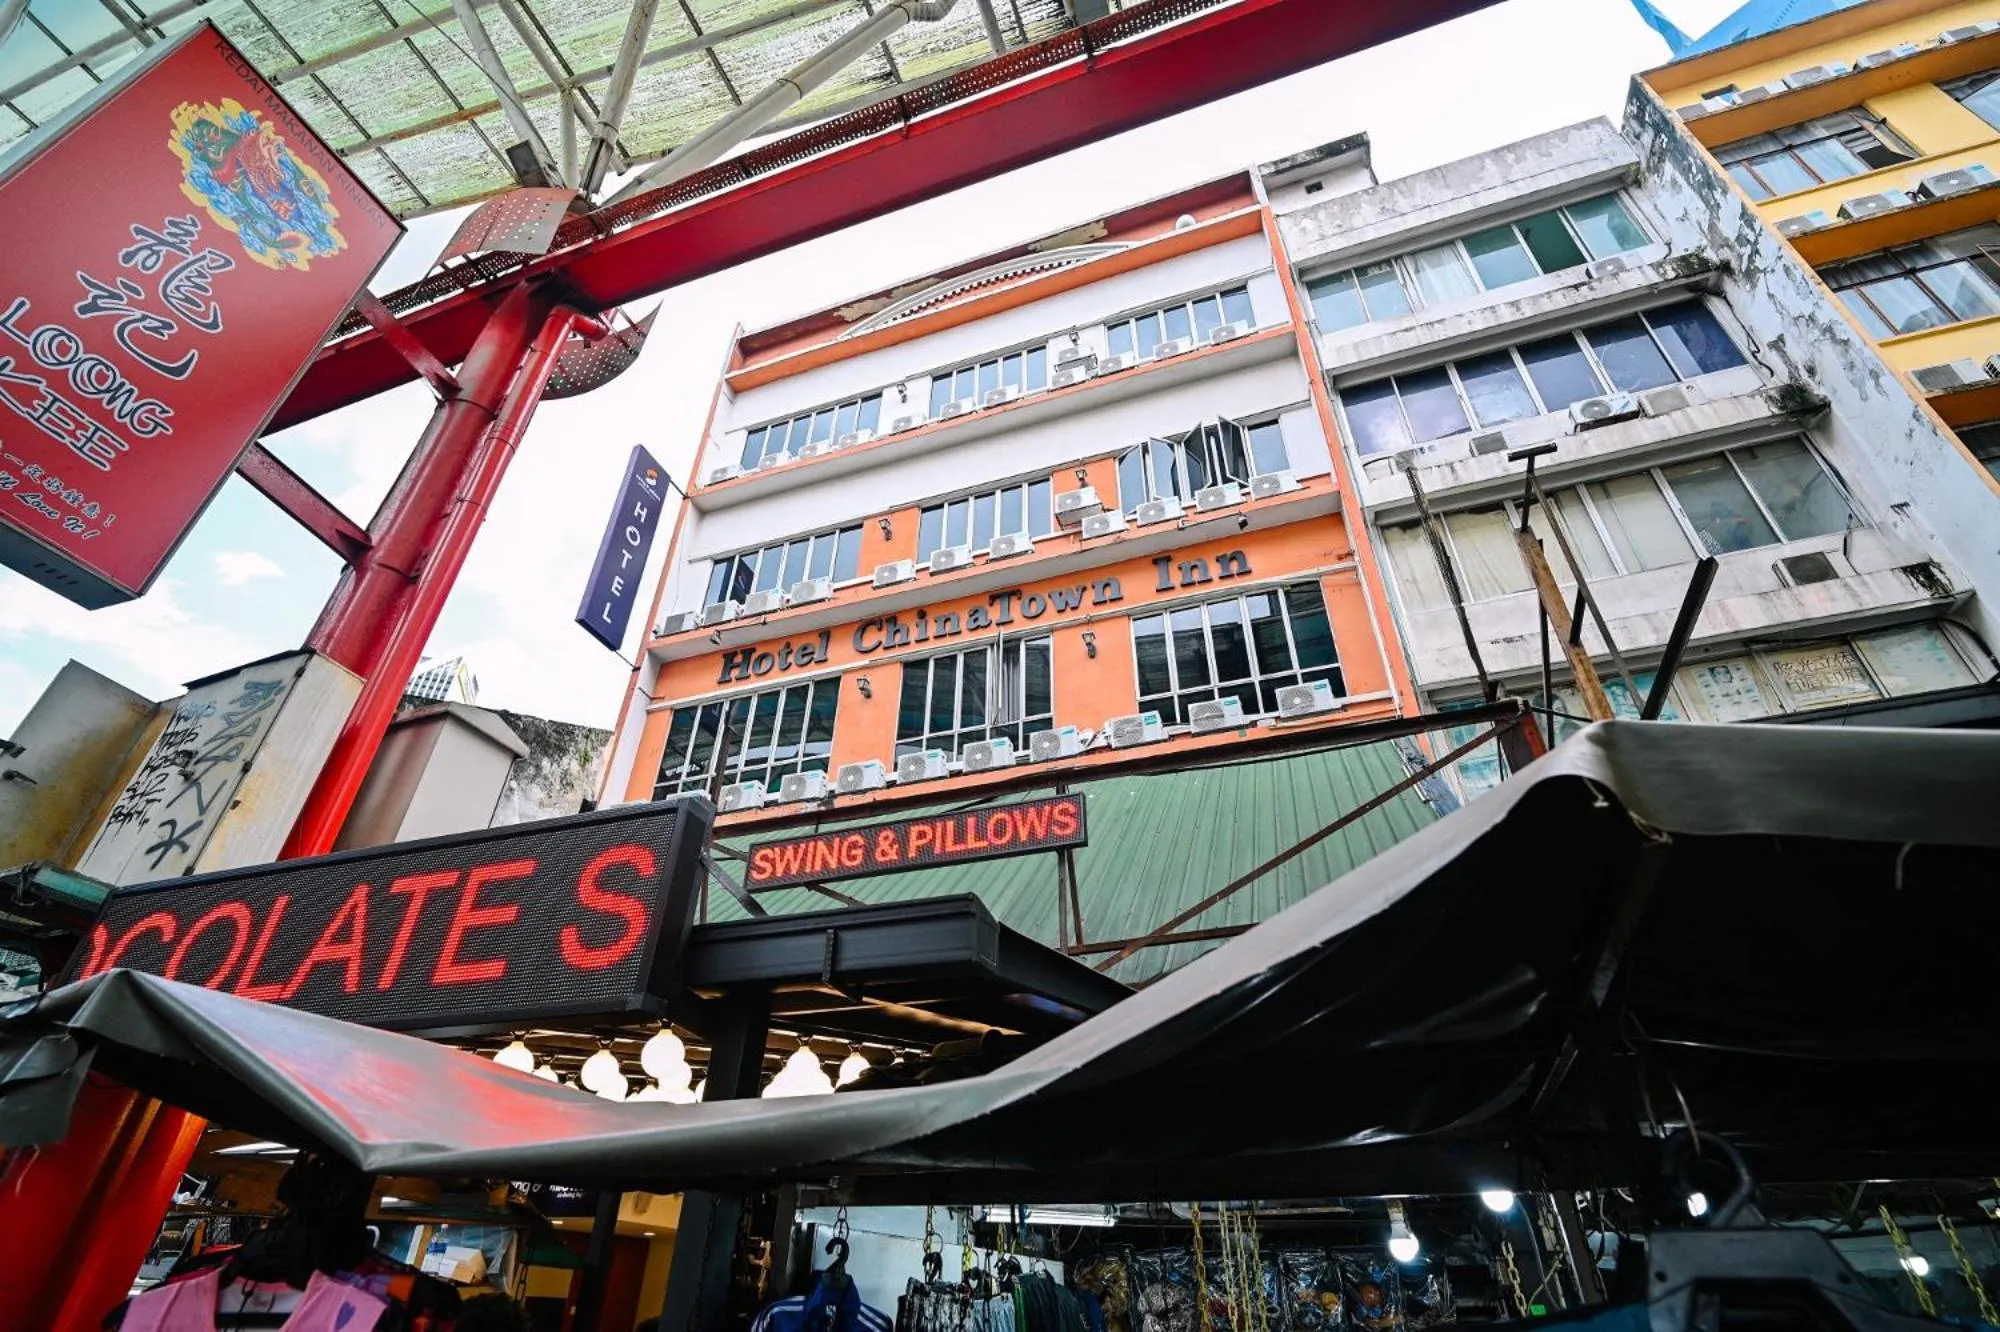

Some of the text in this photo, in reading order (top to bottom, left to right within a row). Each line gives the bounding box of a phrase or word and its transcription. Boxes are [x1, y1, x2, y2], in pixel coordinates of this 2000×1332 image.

[215, 40, 388, 229] KEDAI MAKANAN RINGAN
[0, 297, 174, 437] LOONG
[14, 492, 60, 519] Love
[602, 501, 648, 624] HOTEL
[717, 548, 1253, 684] Hotel ChinaTown Inn
[751, 802, 1080, 881] SWING & PILLOWS
[558, 844, 658, 970] S
